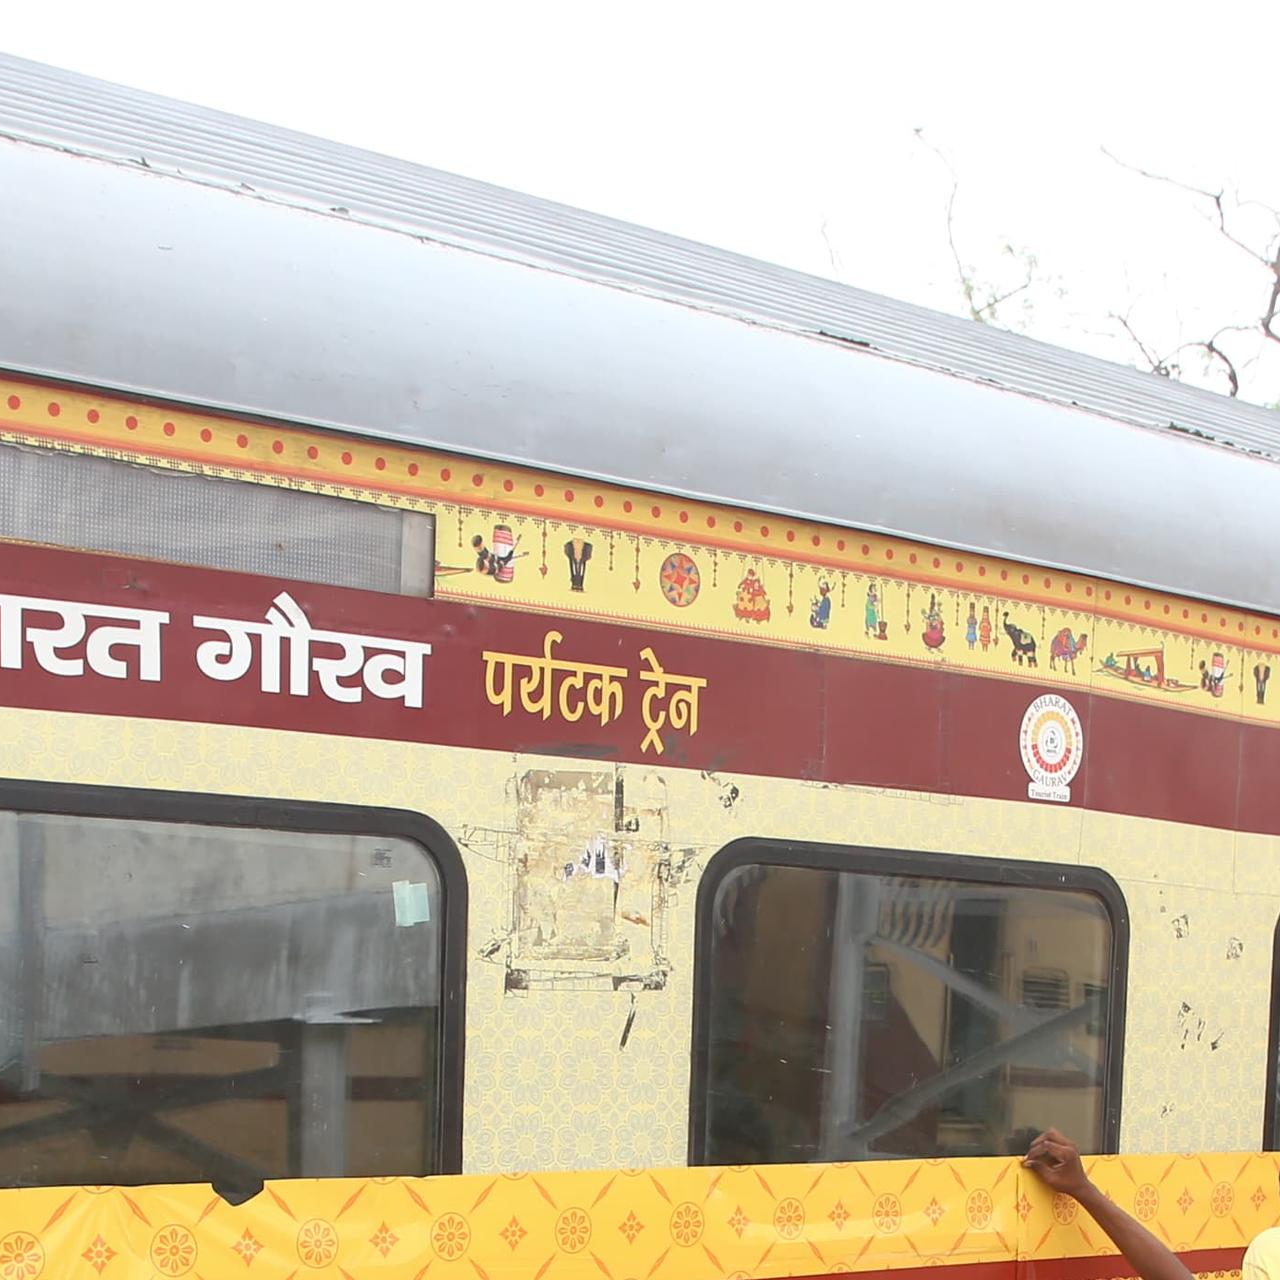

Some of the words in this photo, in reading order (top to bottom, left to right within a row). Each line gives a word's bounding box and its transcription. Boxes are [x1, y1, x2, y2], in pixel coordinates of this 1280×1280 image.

[192, 591, 432, 708] गौरव
[482, 631, 628, 724] पर्यटक
[638, 646, 708, 753] ट्रेन
[1033, 696, 1072, 715] BHARAT
[1033, 769, 1068, 788] GAURAV
